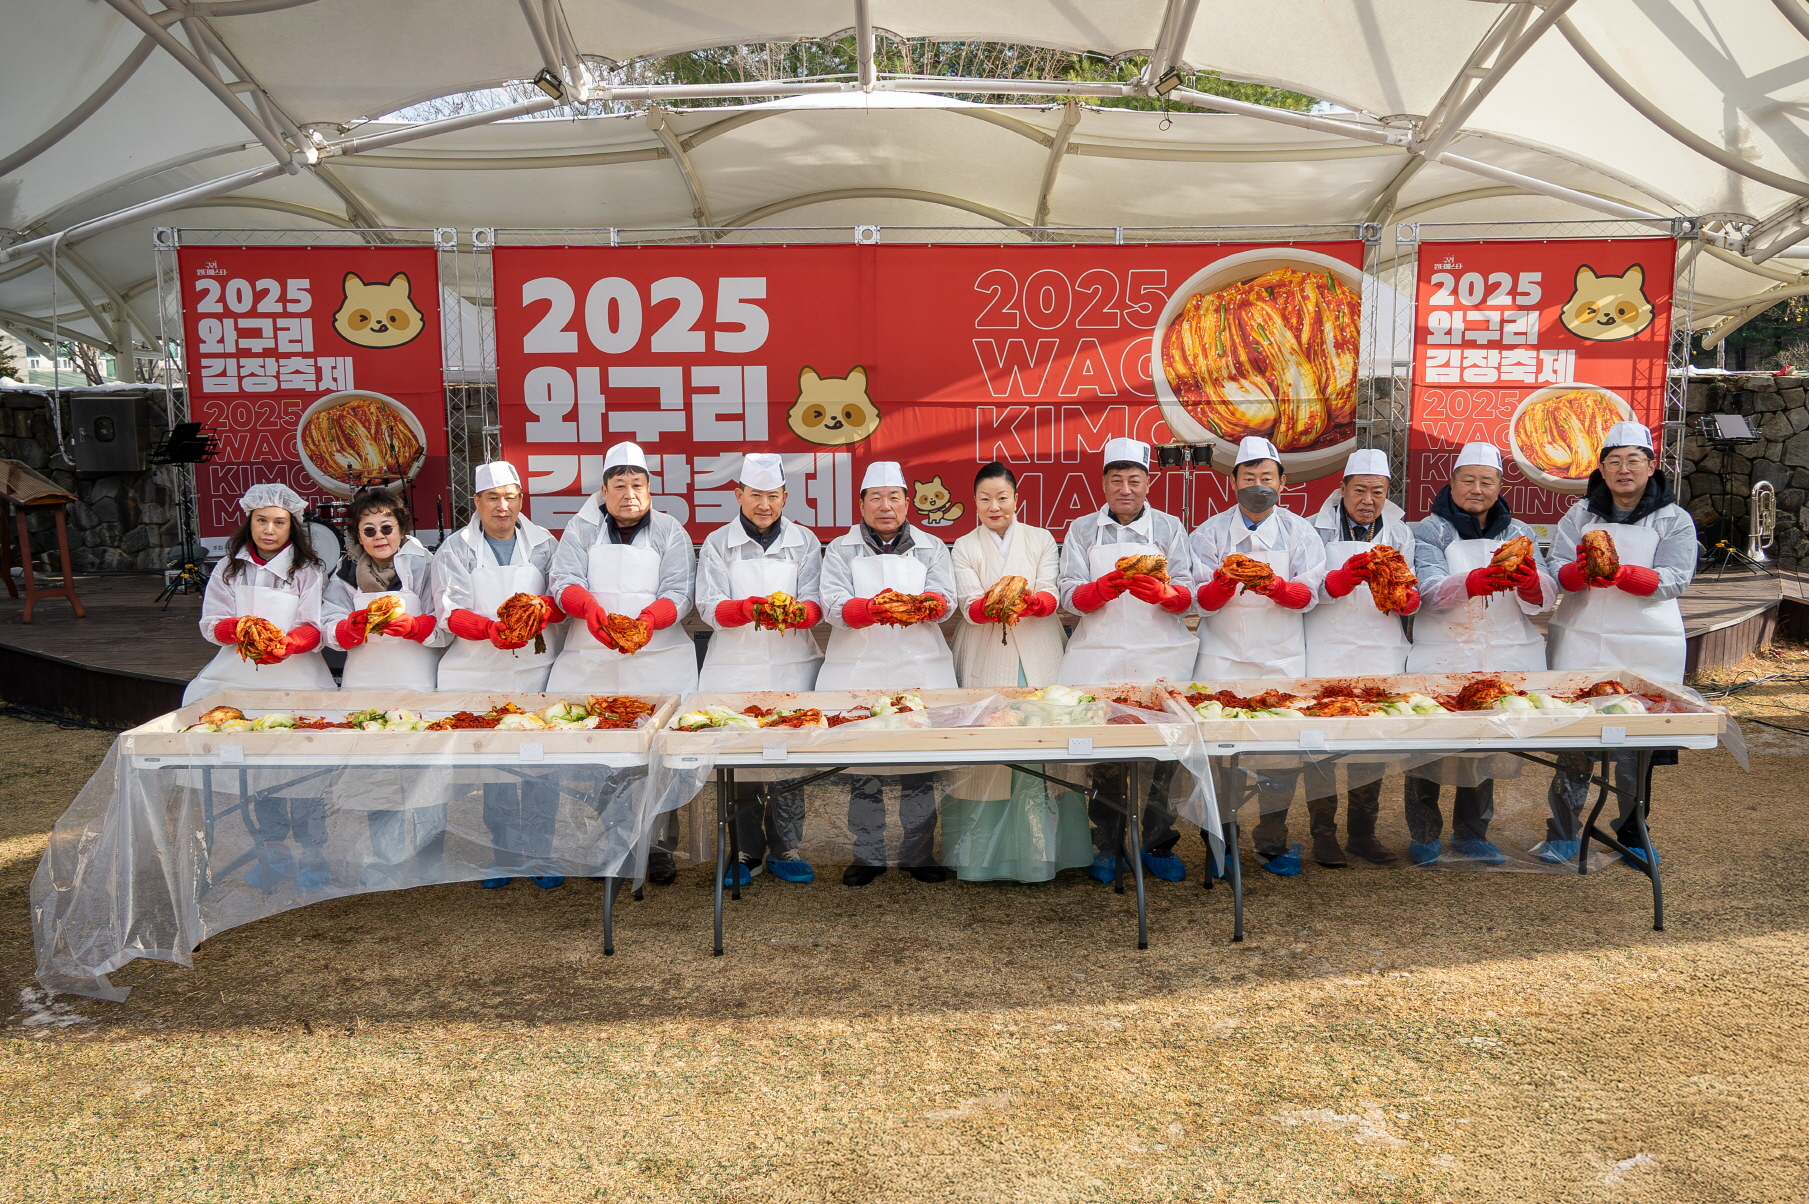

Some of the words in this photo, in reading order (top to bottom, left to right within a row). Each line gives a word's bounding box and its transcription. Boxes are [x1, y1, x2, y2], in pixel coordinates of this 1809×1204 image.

[195, 278, 312, 313] 2025
[974, 268, 1169, 331] 2025
[1429, 271, 1543, 306] 2025
[522, 276, 770, 354] 2025
[1426, 310, 1540, 345] 와구리
[197, 317, 314, 353] 와구리
[201, 356, 355, 393] 김장축제
[1425, 348, 1576, 384] 김장축제
[203, 400, 304, 430] 2025
[523, 365, 769, 443] 와구리
[1423, 389, 1520, 420] 2025
